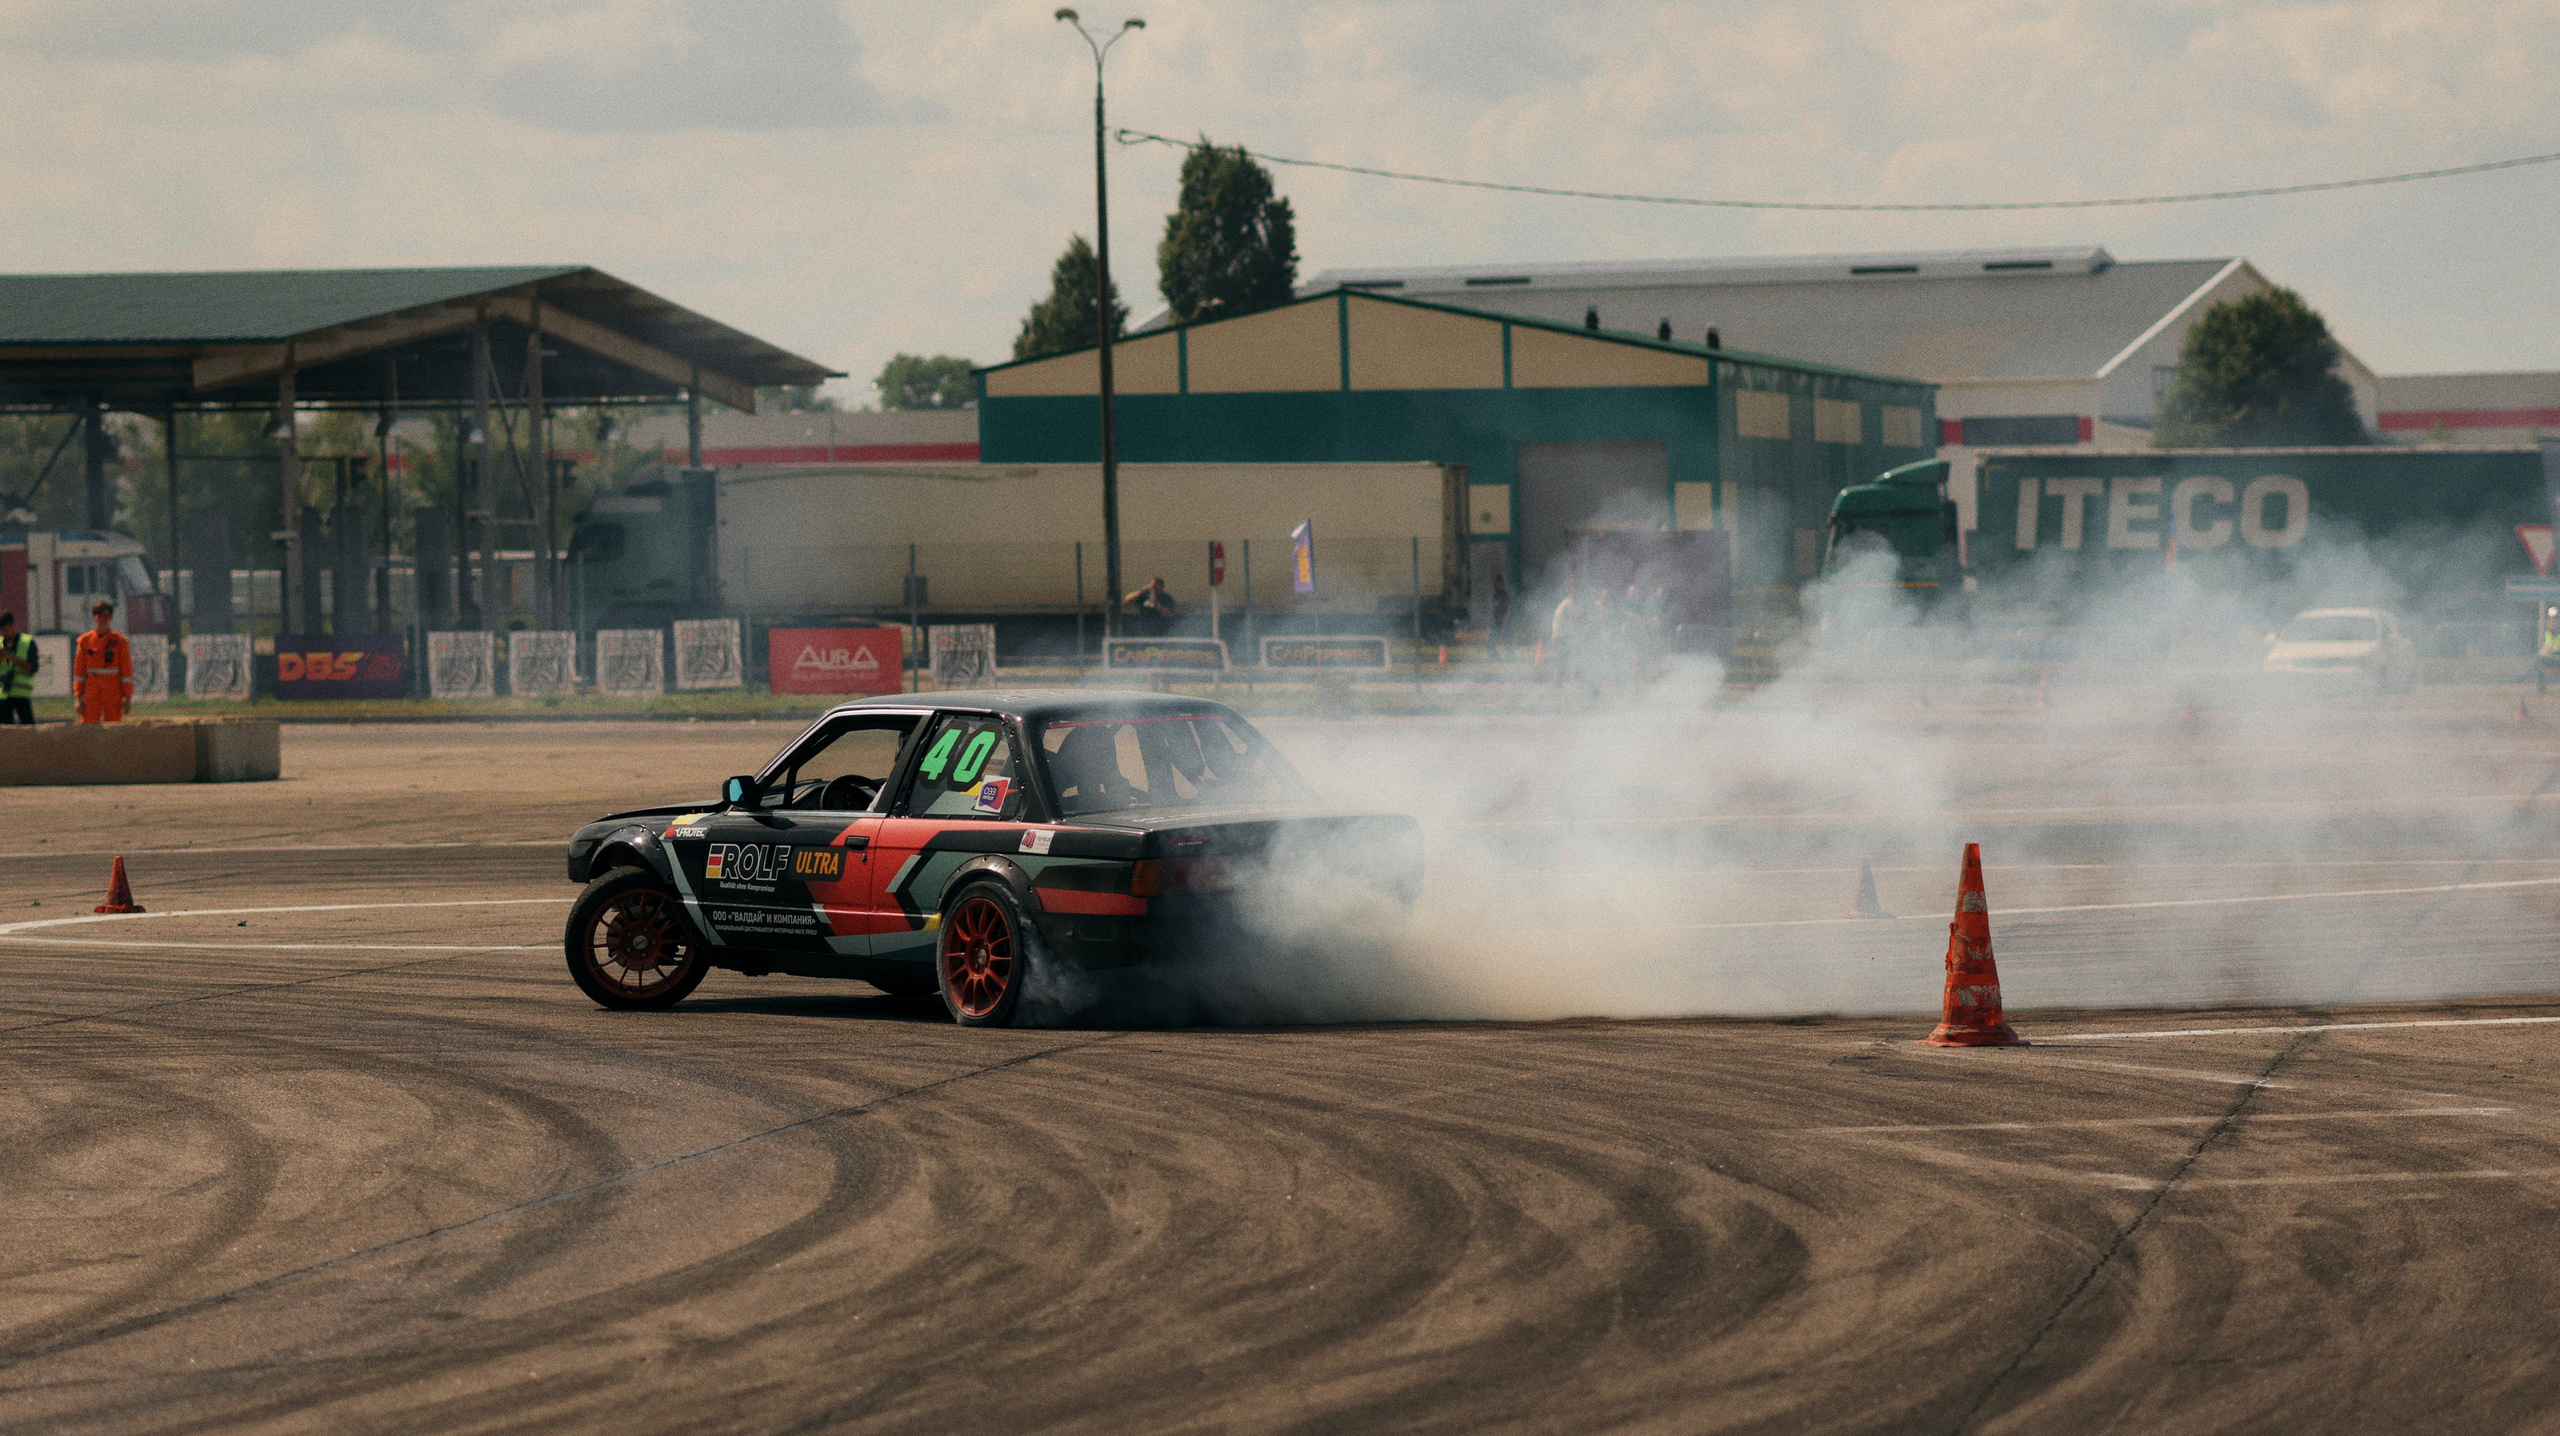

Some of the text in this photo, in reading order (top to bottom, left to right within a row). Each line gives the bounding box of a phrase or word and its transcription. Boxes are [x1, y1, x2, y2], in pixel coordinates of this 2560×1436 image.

[2016, 474, 2310, 549] ITECO
[278, 653, 364, 681] DBS
[793, 645, 880, 670] AURA
[919, 728, 995, 783] 40
[720, 843, 791, 881] ROLF
[796, 851, 839, 875] ULTRA
[713, 911, 727, 920] ООО
[766, 913, 772, 921] И
